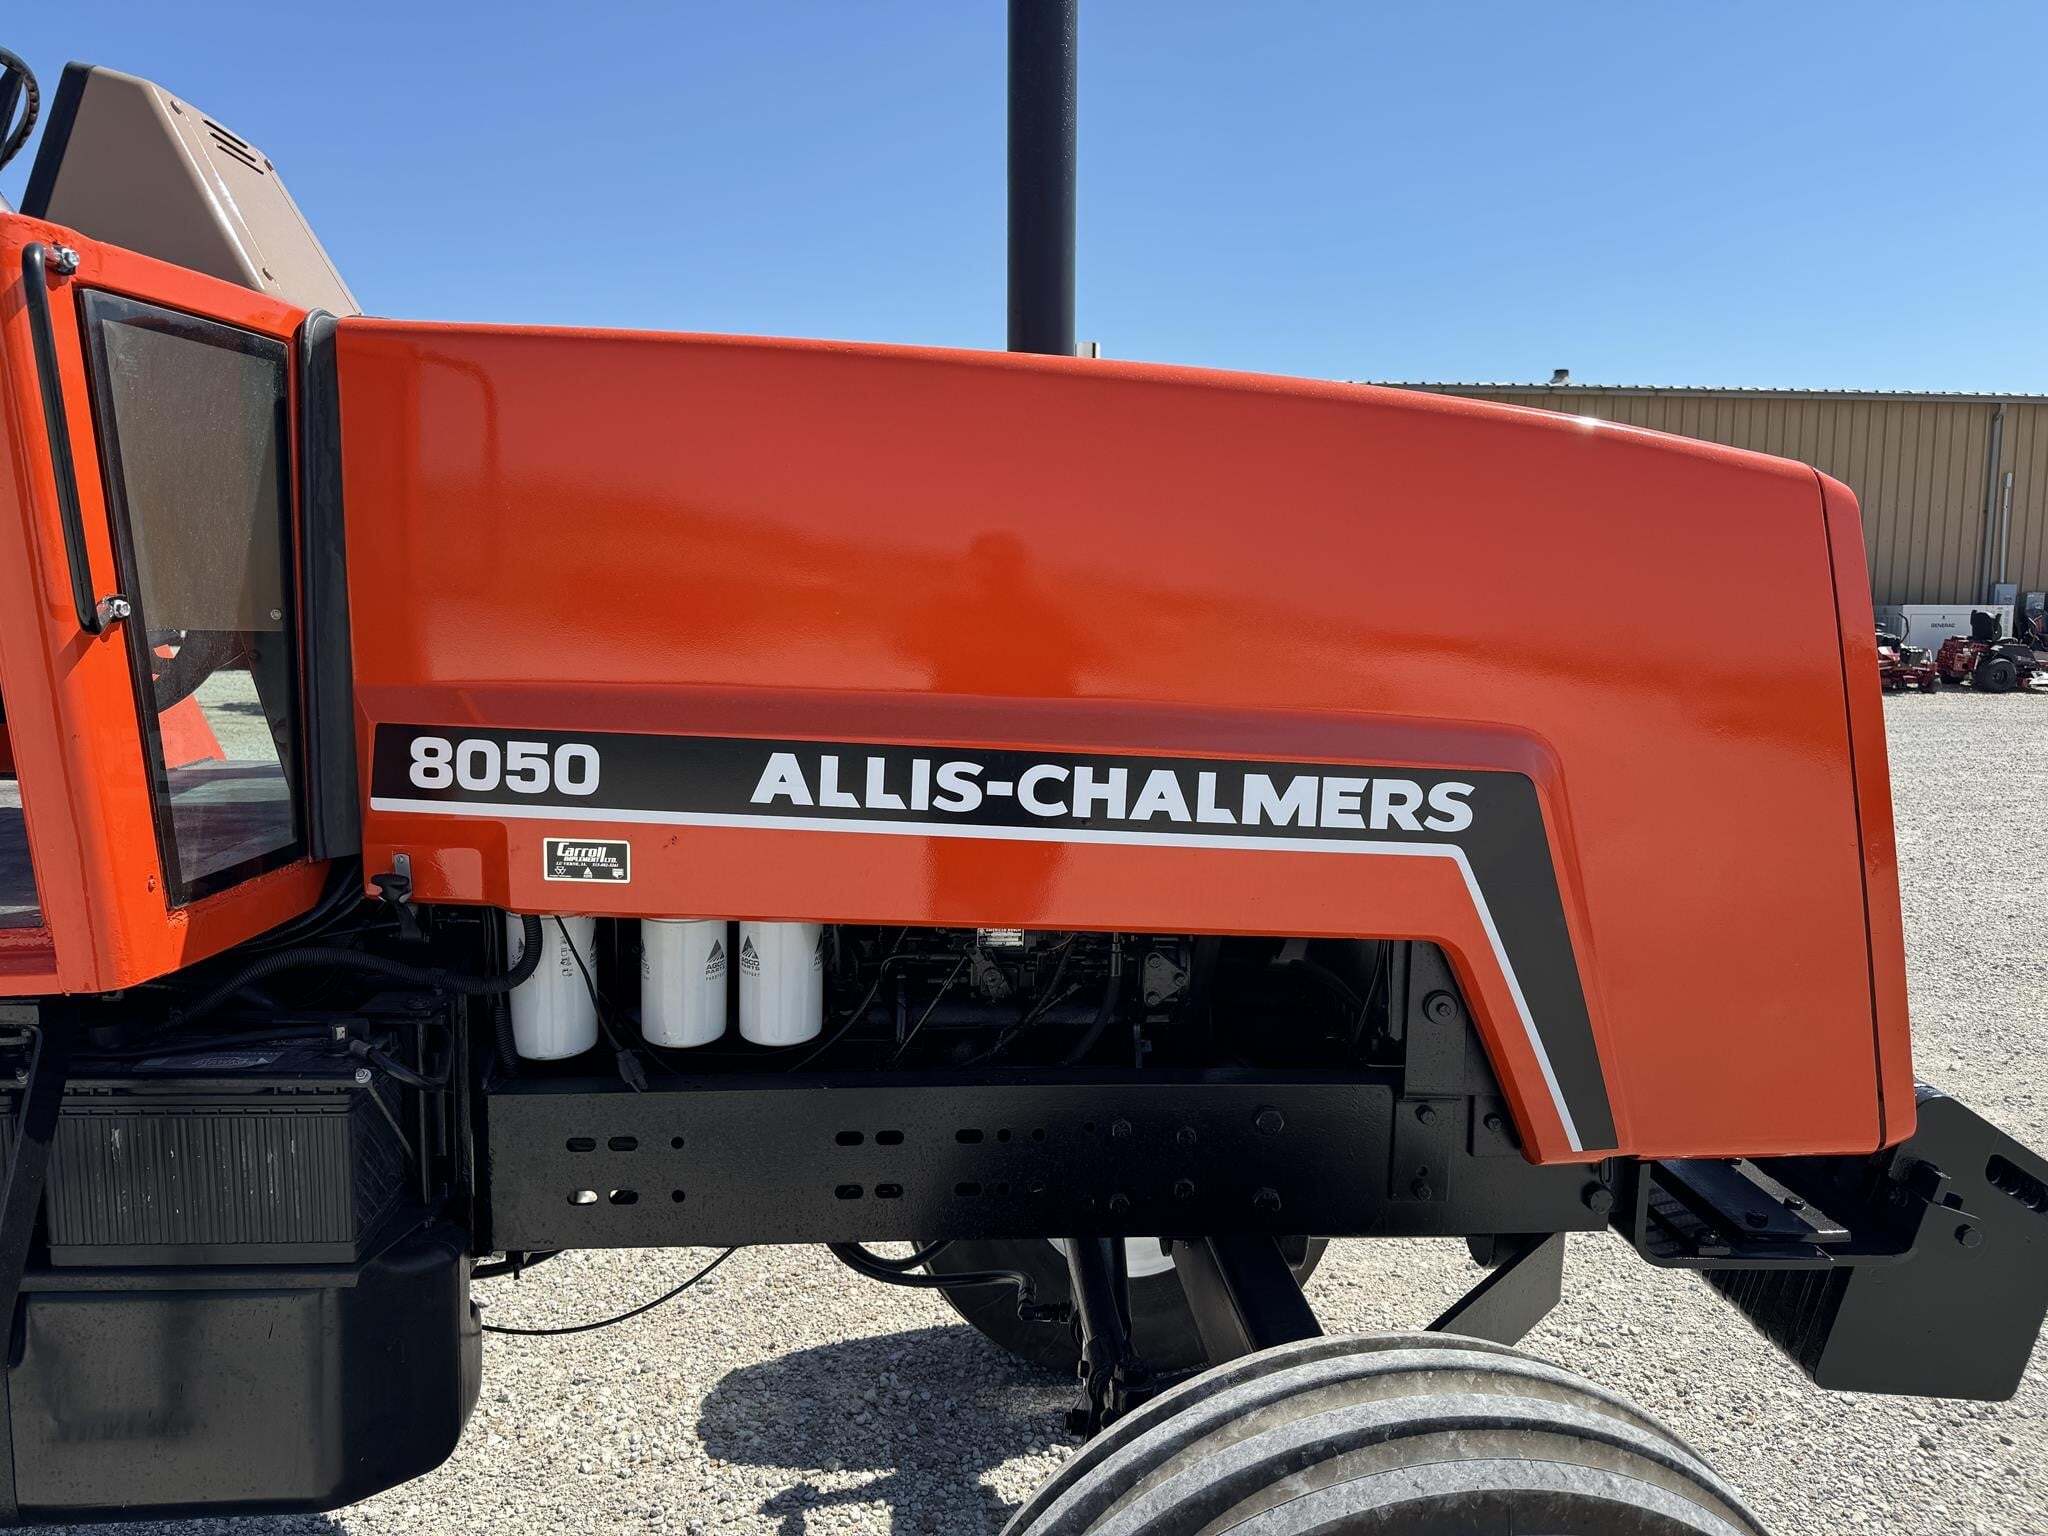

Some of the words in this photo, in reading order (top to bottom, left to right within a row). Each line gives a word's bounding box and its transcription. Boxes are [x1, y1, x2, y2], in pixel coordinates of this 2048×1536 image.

[409, 736, 600, 796] 8050
[750, 752, 1475, 833] ALLIS-CHALMERS
[556, 842, 607, 862] Carroll
